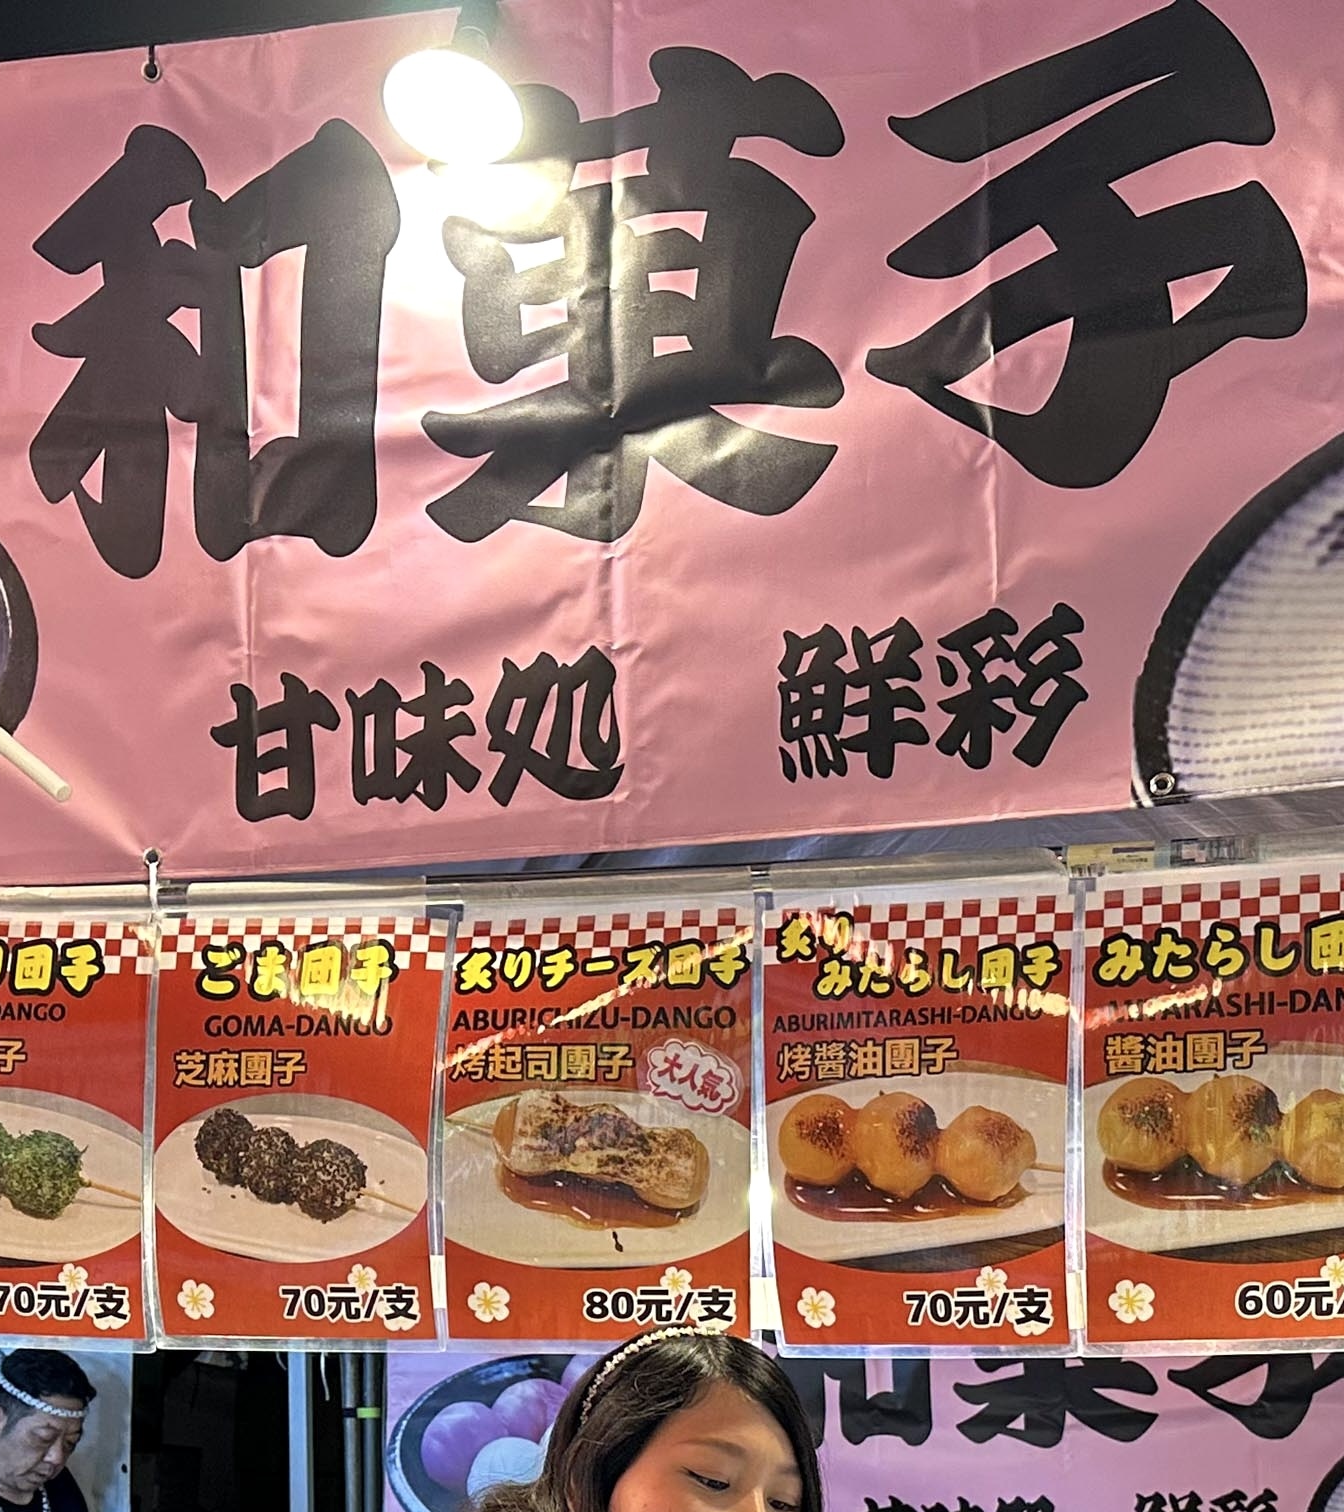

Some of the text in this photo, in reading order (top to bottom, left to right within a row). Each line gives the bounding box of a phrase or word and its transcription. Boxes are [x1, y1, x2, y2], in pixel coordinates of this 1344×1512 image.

[29, 0, 1309, 579] 和菓子
[777, 602, 1090, 784] 鮮彩
[211, 644, 625, 823] 甘味処
[198, 940, 395, 998] ごま団子
[457, 940, 750, 993] 炙りチーズ団子
[817, 944, 1059, 998] みたらし団子
[204, 1015, 393, 1038] GOMA-DANGO
[452, 1006, 736, 1032] ABURICHIZU-DANGO
[772, 1004, 1044, 1033] ABURIMITARASHI-DANGO
[174, 1050, 306, 1087] 芝麻團子
[449, 1043, 633, 1081] 烤起司團子
[777, 1036, 957, 1081] 烤醬油團子
[1106, 1031, 1267, 1075] 醬油團子
[279, 1287, 420, 1322] 70元/支
[584, 1287, 736, 1326] 80元/支
[903, 1288, 1053, 1327] 70元/支
